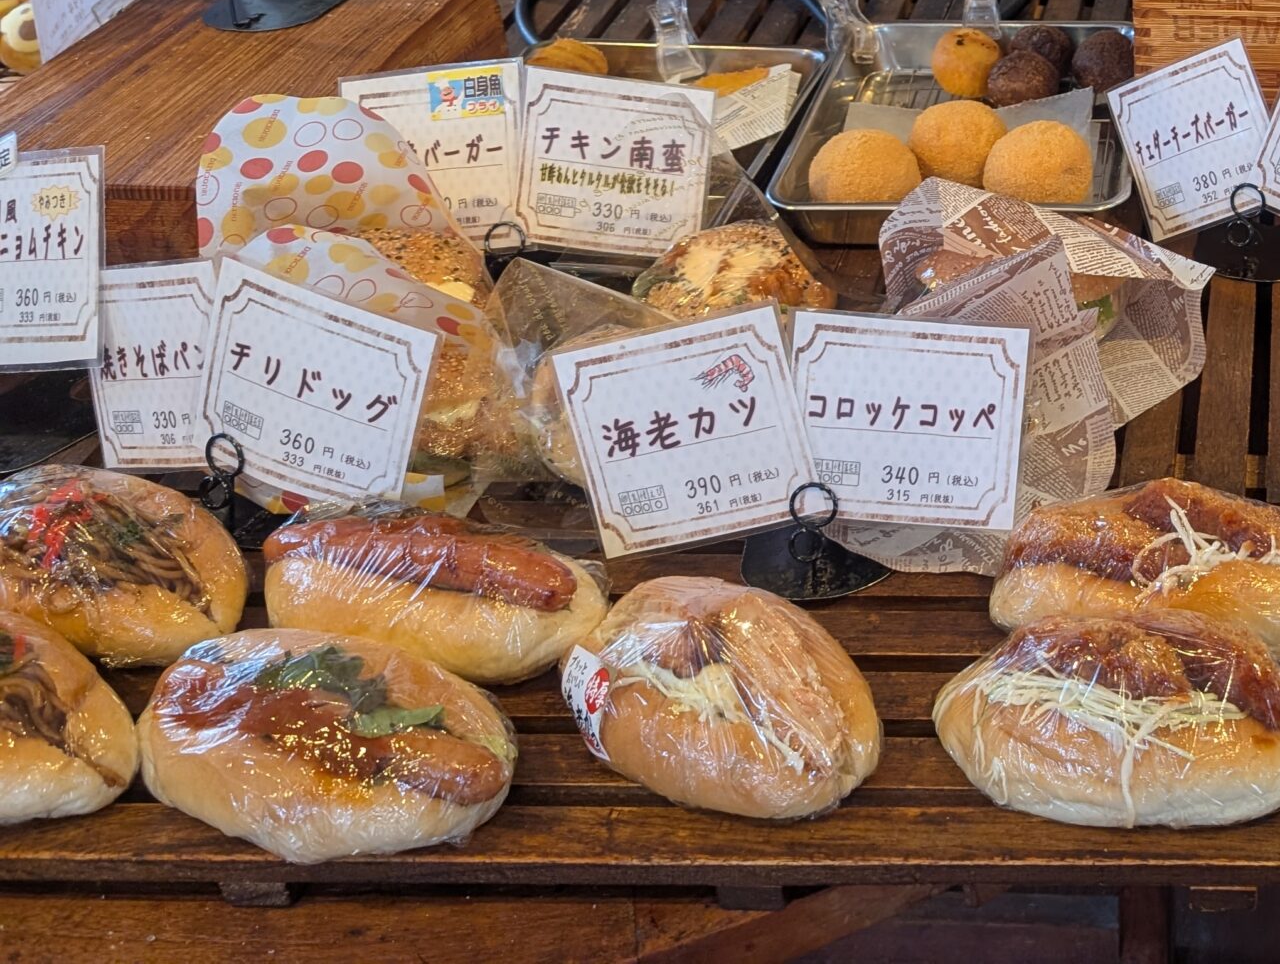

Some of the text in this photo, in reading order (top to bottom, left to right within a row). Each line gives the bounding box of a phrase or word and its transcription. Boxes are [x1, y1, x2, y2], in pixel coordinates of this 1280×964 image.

[463, 73, 502, 99] 白身魚
[466, 99, 500, 115] フライ
[1135, 101, 1249, 166] チェダーチーズバーガー
[542, 127, 686, 173] チキン南蛮
[1192, 170, 1217, 191] 380
[1202, 190, 1218, 203] 352
[592, 202, 623, 219] 330
[596, 221, 615, 232] 306
[16, 288, 39, 307] 360
[19, 311, 34, 323] 333
[229, 341, 400, 423] チリドッグ
[152, 410, 177, 430] 330
[808, 394, 997, 432] コロッケコッペ
[601, 394, 758, 458] 海老カツ
[160, 433, 177, 446] 306
[279, 428, 315, 455] 360
[282, 451, 306, 467] 333
[880, 464, 920, 486] 340
[684, 474, 723, 500] 390
[886, 487, 910, 502] 315
[696, 498, 720, 515] 361
